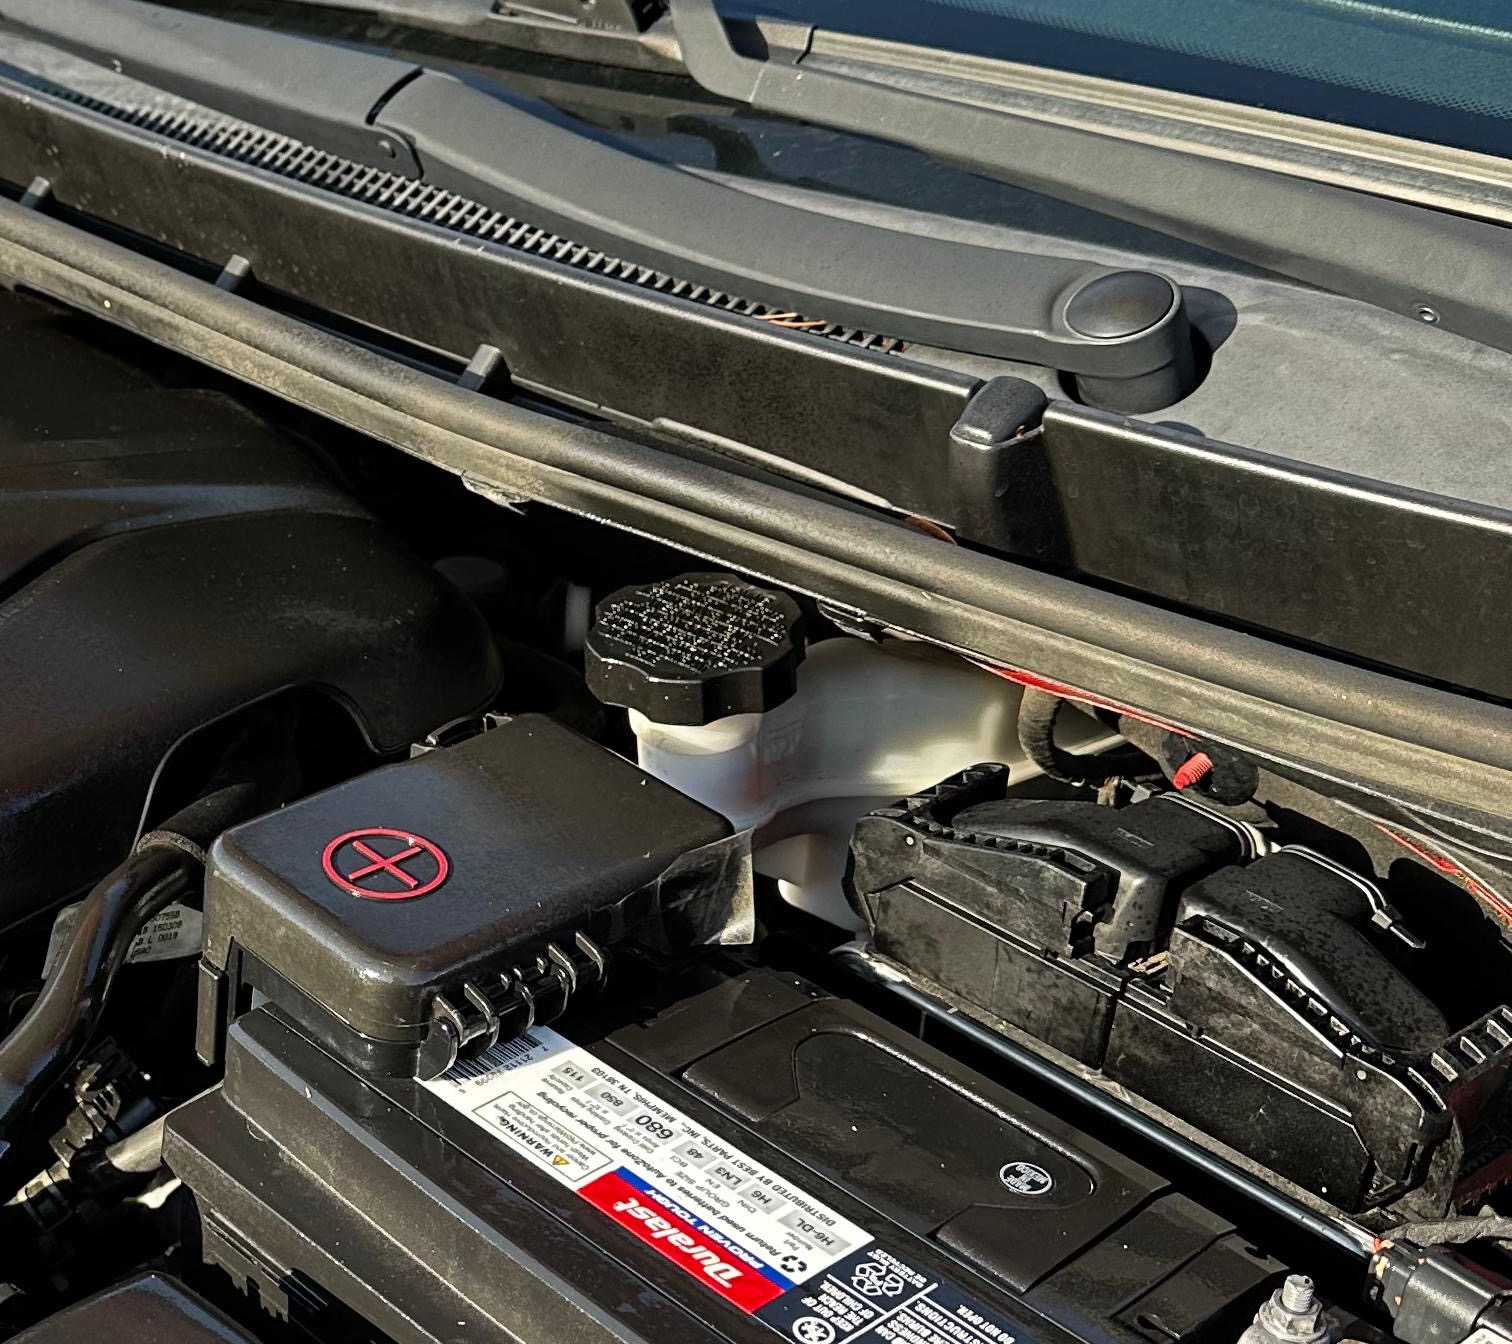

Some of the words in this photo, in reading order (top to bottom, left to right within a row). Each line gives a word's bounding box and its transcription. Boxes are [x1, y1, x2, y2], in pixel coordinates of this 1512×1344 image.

[561, 1067, 586, 1081] 115
[591, 1067, 619, 1084] 38103
[616, 1084, 632, 1092] TN
[534, 1091, 578, 1118] recycling
[599, 1091, 624, 1106] 850
[629, 1092, 677, 1121] MEMPHIS,
[575, 1117, 608, 1138] proper
[632, 1114, 675, 1139] 680
[550, 1144, 565, 1153] and
[604, 1139, 621, 1148] for
[698, 1137, 734, 1158] PARTS,
[669, 1155, 688, 1166] BCI
[685, 1148, 705, 1159] 48
[619, 1148, 666, 1178] AutoZone
[732, 1159, 758, 1174] BEST
[674, 1171, 696, 1184] SIZE
[714, 1166, 743, 1184] LN3
[756, 1175, 772, 1184] BY
[1015, 1163, 1049, 1183] MEXICO
[704, 1179, 720, 1188] EN
[1006, 1175, 1031, 1191] MADE
[674, 1186, 720, 1215] batteries
[694, 1184, 730, 1207] GROUP
[749, 1190, 772, 1203] H6
[644, 1188, 698, 1224] TOUGH
[736, 1200, 757, 1212] DIN
[770, 1184, 835, 1225] DISTRIBUTED
[718, 1215, 745, 1232] used
[792, 1218, 835, 1245] H6-DL
[610, 1196, 746, 1287] Duralast
[696, 1224, 763, 1268] PROVEN
[743, 1232, 780, 1255] Return
[782, 1239, 799, 1250] Part
[785, 1231, 813, 1249] Number
[866, 1250, 889, 1265] MUST
[874, 1248, 915, 1274] RECYCLED
[887, 1264, 924, 1287] BATTERY
[799, 1295, 818, 1306] OF
[816, 1280, 864, 1311] CHILDREN.
[816, 1293, 849, 1314] REACH
[811, 1303, 835, 1318] OUT
[843, 1311, 865, 1325] THE
[857, 1307, 875, 1318] OF
[952, 1304, 984, 1324] OPEN.
[828, 1314, 854, 1331] KEEP
[892, 1310, 932, 1336] BURNS.
[978, 1321, 1001, 1336] NOT
[873, 1325, 897, 1340] CAN
[995, 1332, 1015, 1344] DO
